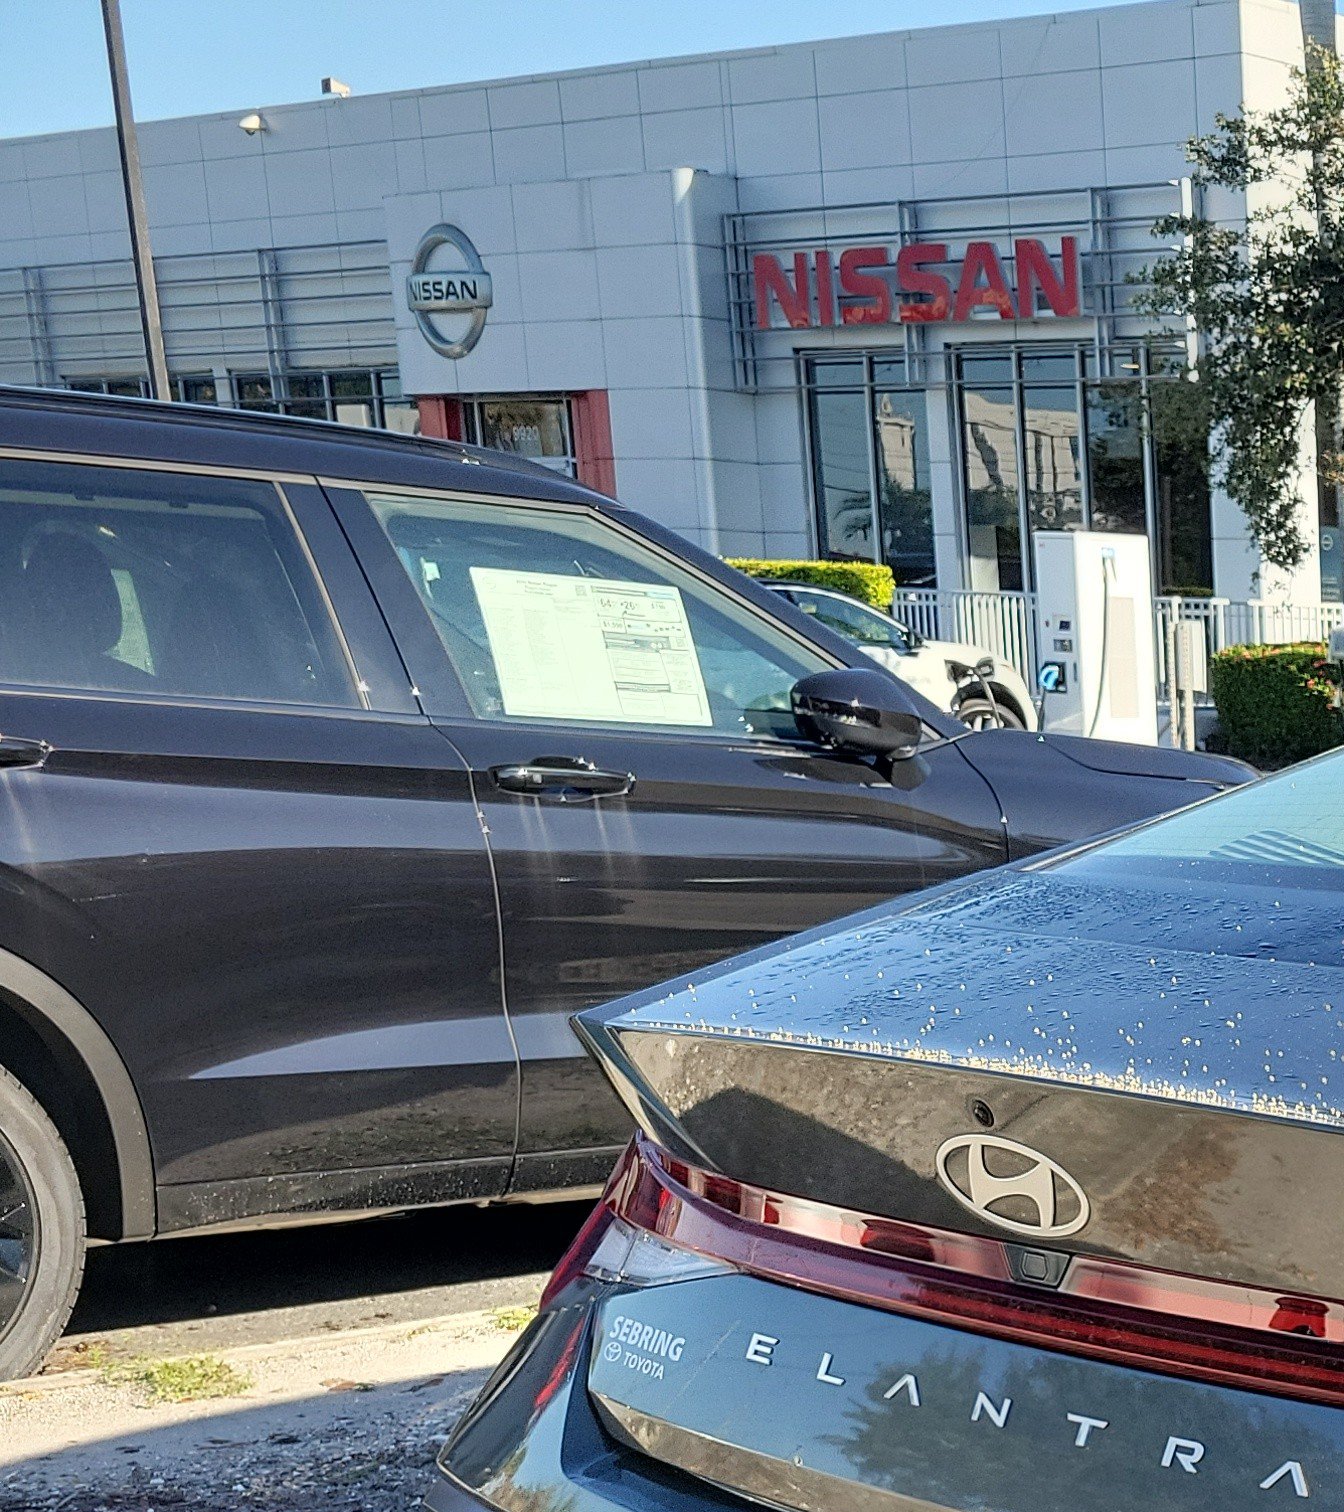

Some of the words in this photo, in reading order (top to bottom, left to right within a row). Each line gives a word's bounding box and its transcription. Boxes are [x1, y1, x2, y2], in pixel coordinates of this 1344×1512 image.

[409, 280, 478, 301] NISSAN
[753, 236, 1080, 329] NISSAN
[609, 1316, 686, 1362] SEBRING
[623, 1351, 665, 1380] TOYOTA
[745, 1332, 1309, 1498] ELANTRA
